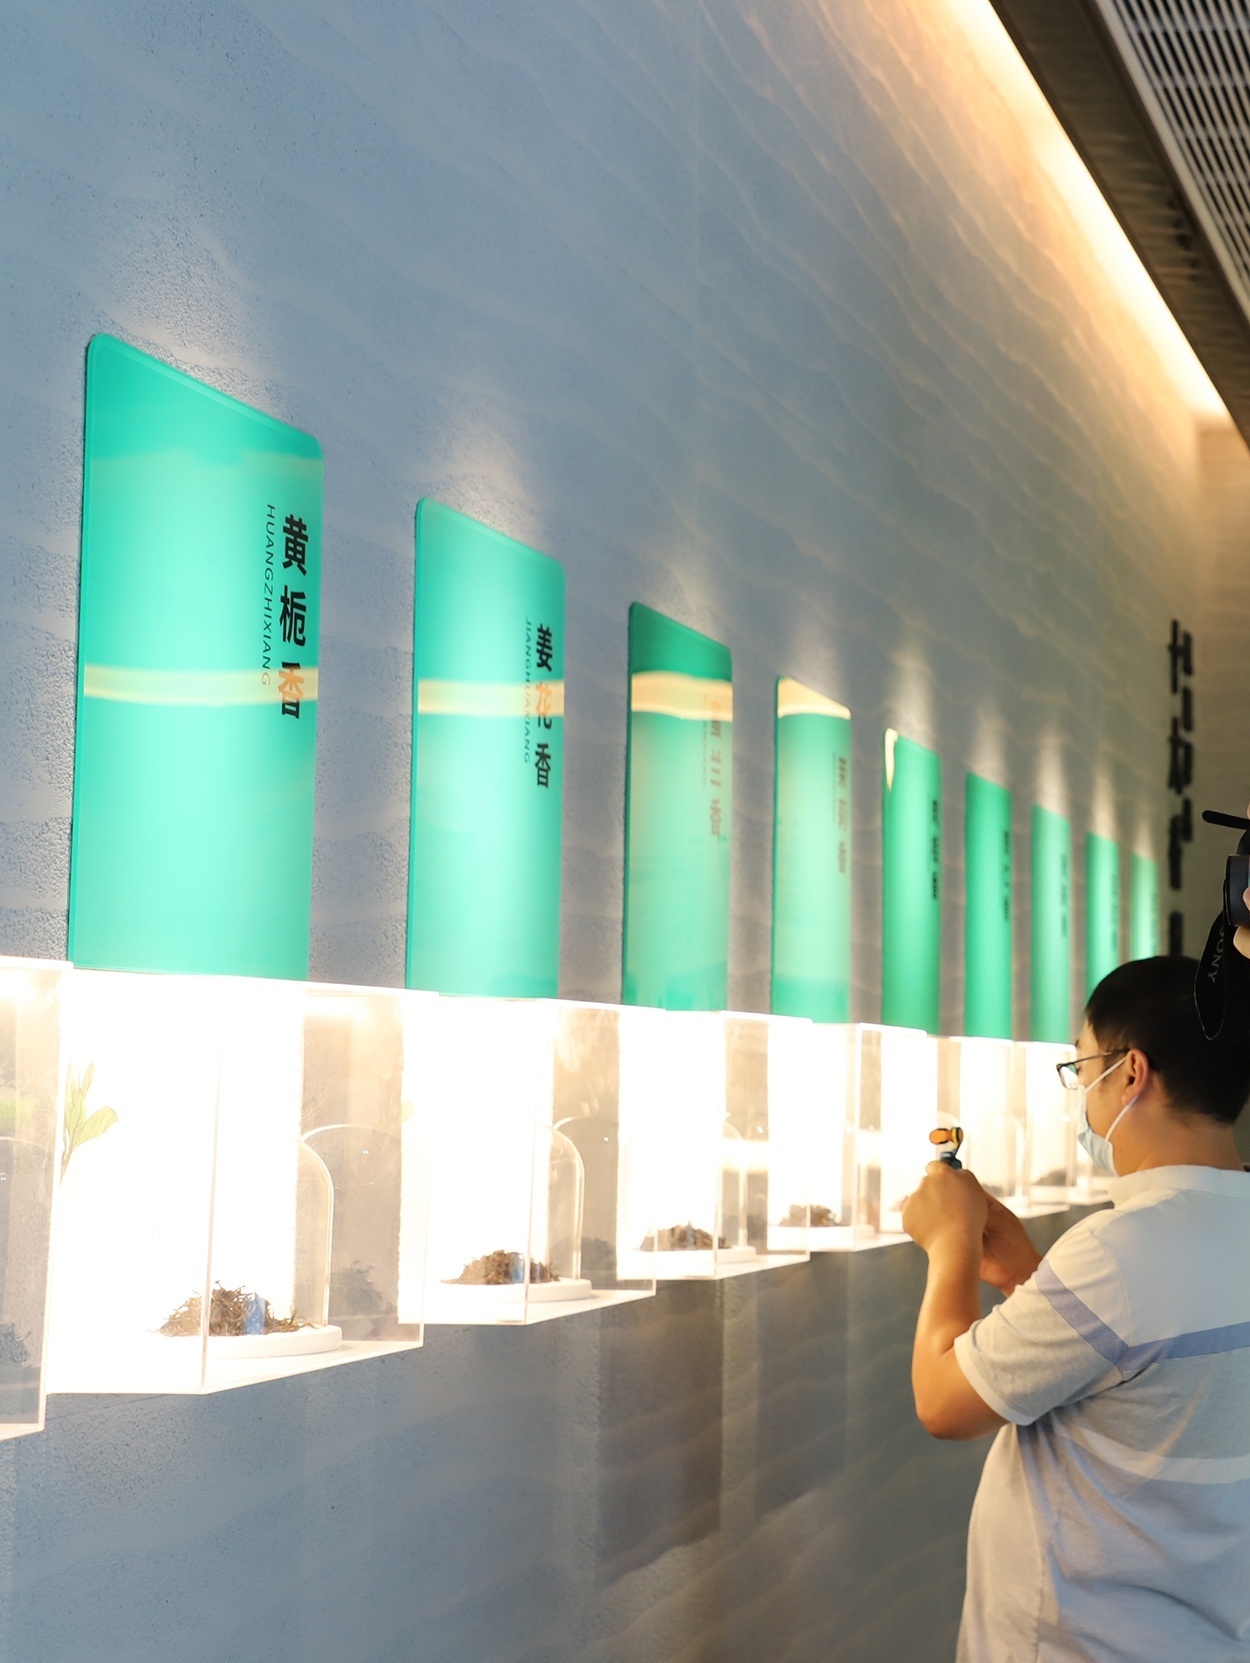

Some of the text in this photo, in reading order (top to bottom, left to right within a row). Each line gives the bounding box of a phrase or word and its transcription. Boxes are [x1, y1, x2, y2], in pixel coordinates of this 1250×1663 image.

[261, 503, 276, 686] HUANGZHIXIANG
[278, 514, 309, 719] 黄栀香
[535, 623, 553, 788] 姜花香
